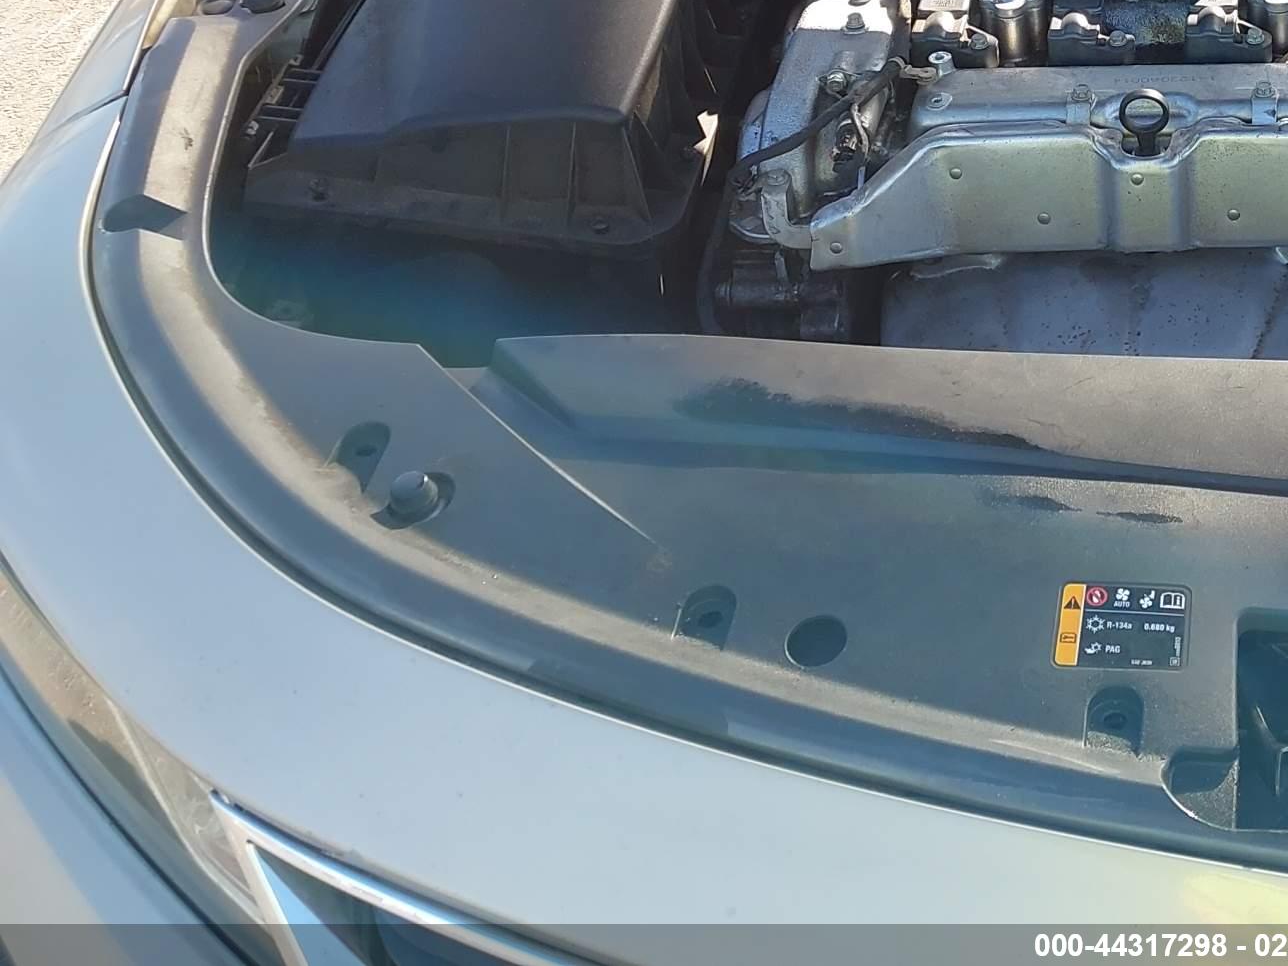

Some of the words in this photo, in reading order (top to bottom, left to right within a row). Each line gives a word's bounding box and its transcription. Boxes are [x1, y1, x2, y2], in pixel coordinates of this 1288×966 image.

[1113, 600, 1131, 608] AUTO
[1106, 621, 1133, 630] R-134a
[1165, 624, 1176, 634] kg
[1105, 644, 1121, 654] PAG
